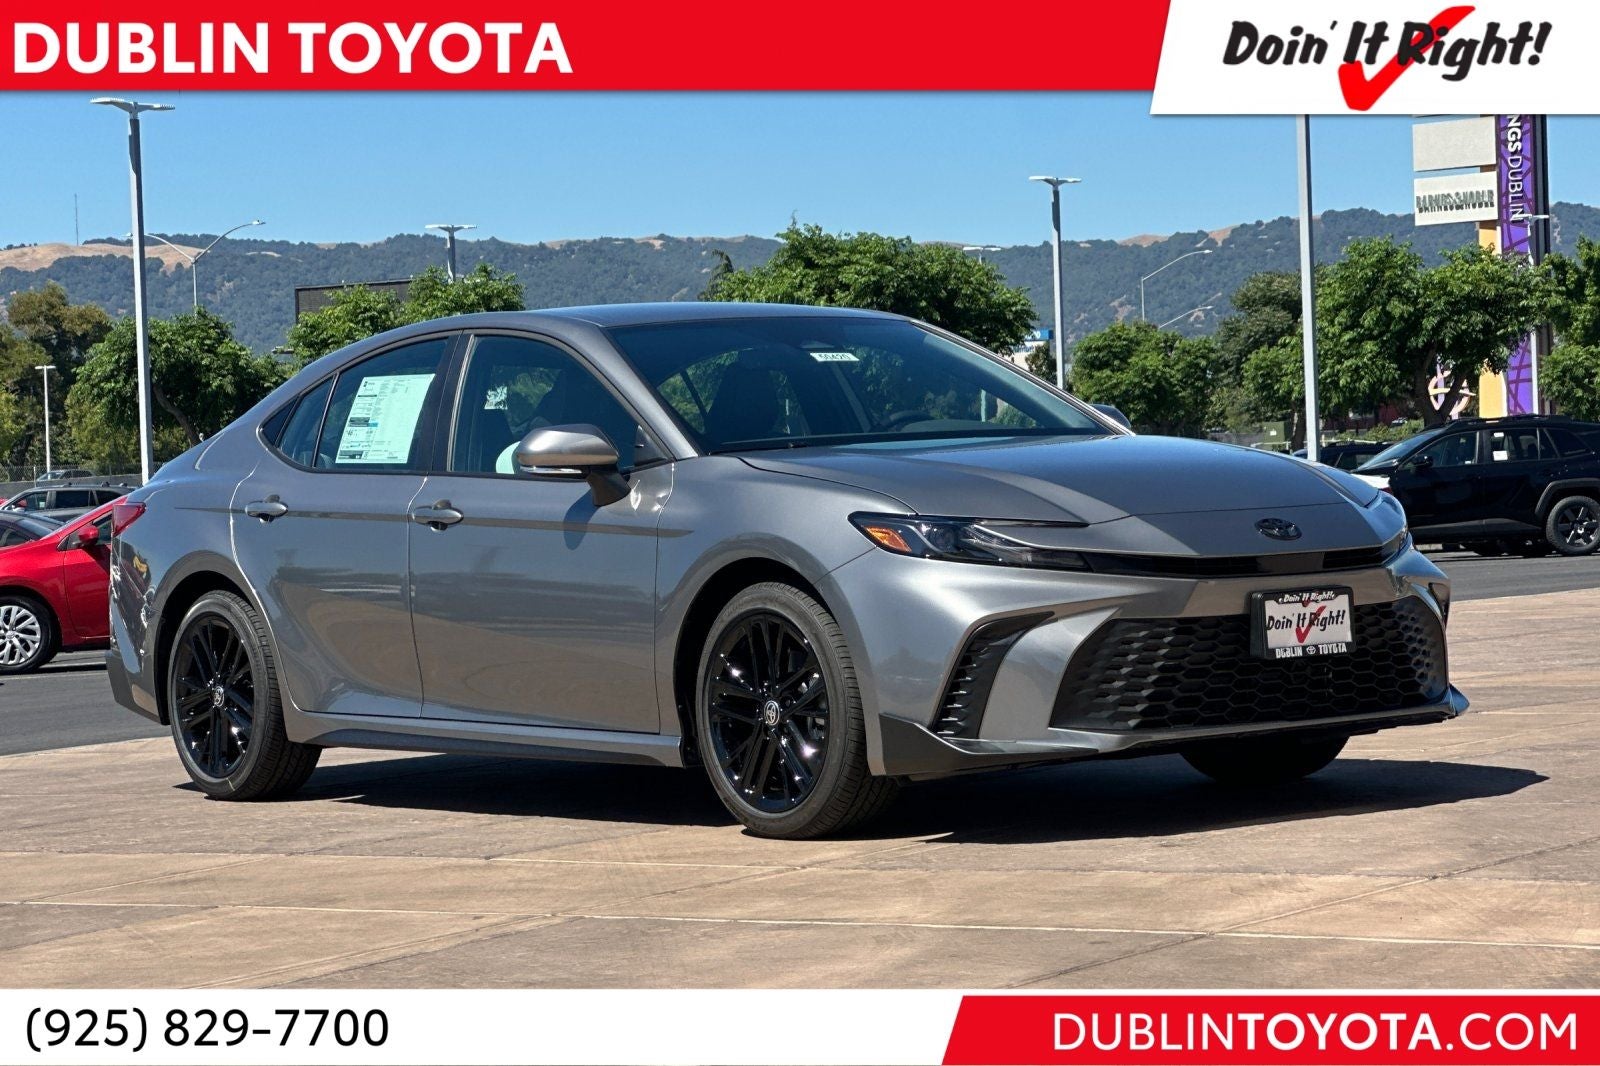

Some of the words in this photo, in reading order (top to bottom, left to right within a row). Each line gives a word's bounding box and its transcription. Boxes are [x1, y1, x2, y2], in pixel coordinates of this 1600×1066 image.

[1507, 156, 1525, 222] DUBLIN
[1266, 612, 1295, 631] Doin'
[1296, 612, 1307, 628] It
[1309, 609, 1346, 632] Right!
[1275, 645, 1303, 659] DUBLIN
[1318, 642, 1348, 655] TOYOTA
